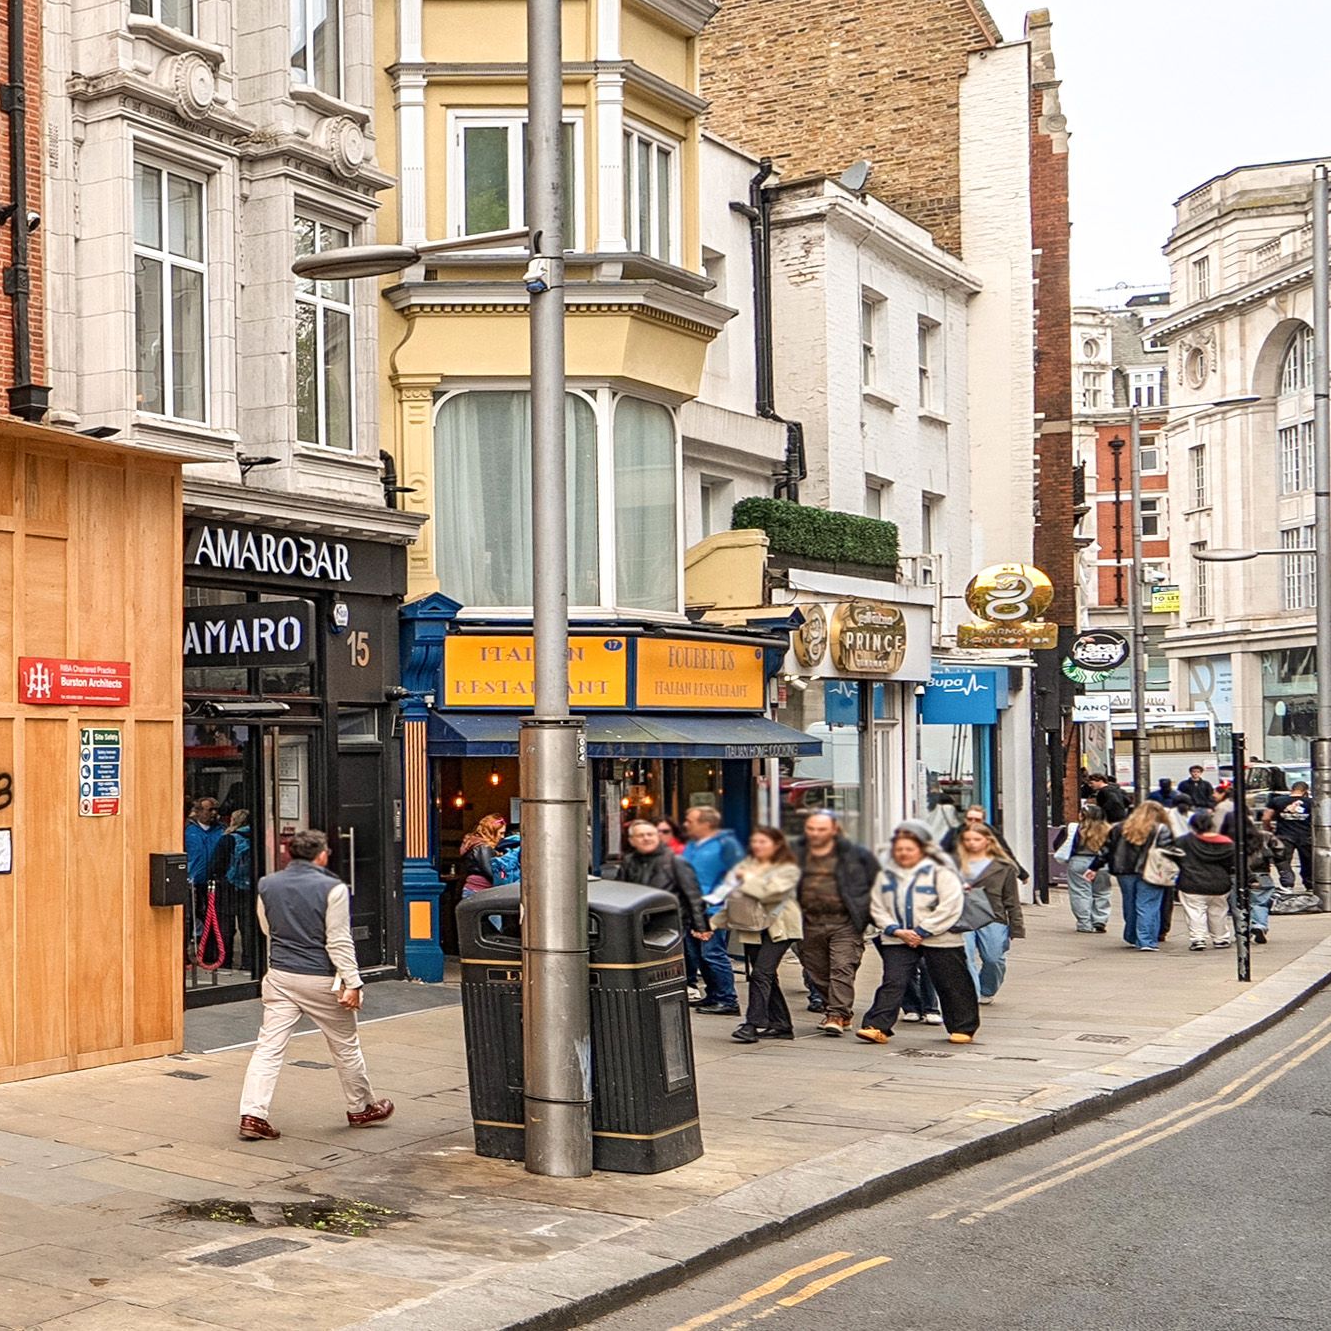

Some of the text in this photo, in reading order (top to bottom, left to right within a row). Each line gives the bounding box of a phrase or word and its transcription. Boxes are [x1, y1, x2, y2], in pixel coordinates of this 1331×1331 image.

[183, 616, 301, 655] AMARO
[846, 631, 902, 653] PRINCE
[347, 631, 370, 667] 15
[608, 641, 619, 649] 17
[480, 646, 584, 662] ITALN
[61, 677, 122, 688] Burston Architects
[926, 678, 963, 688] Bupa
